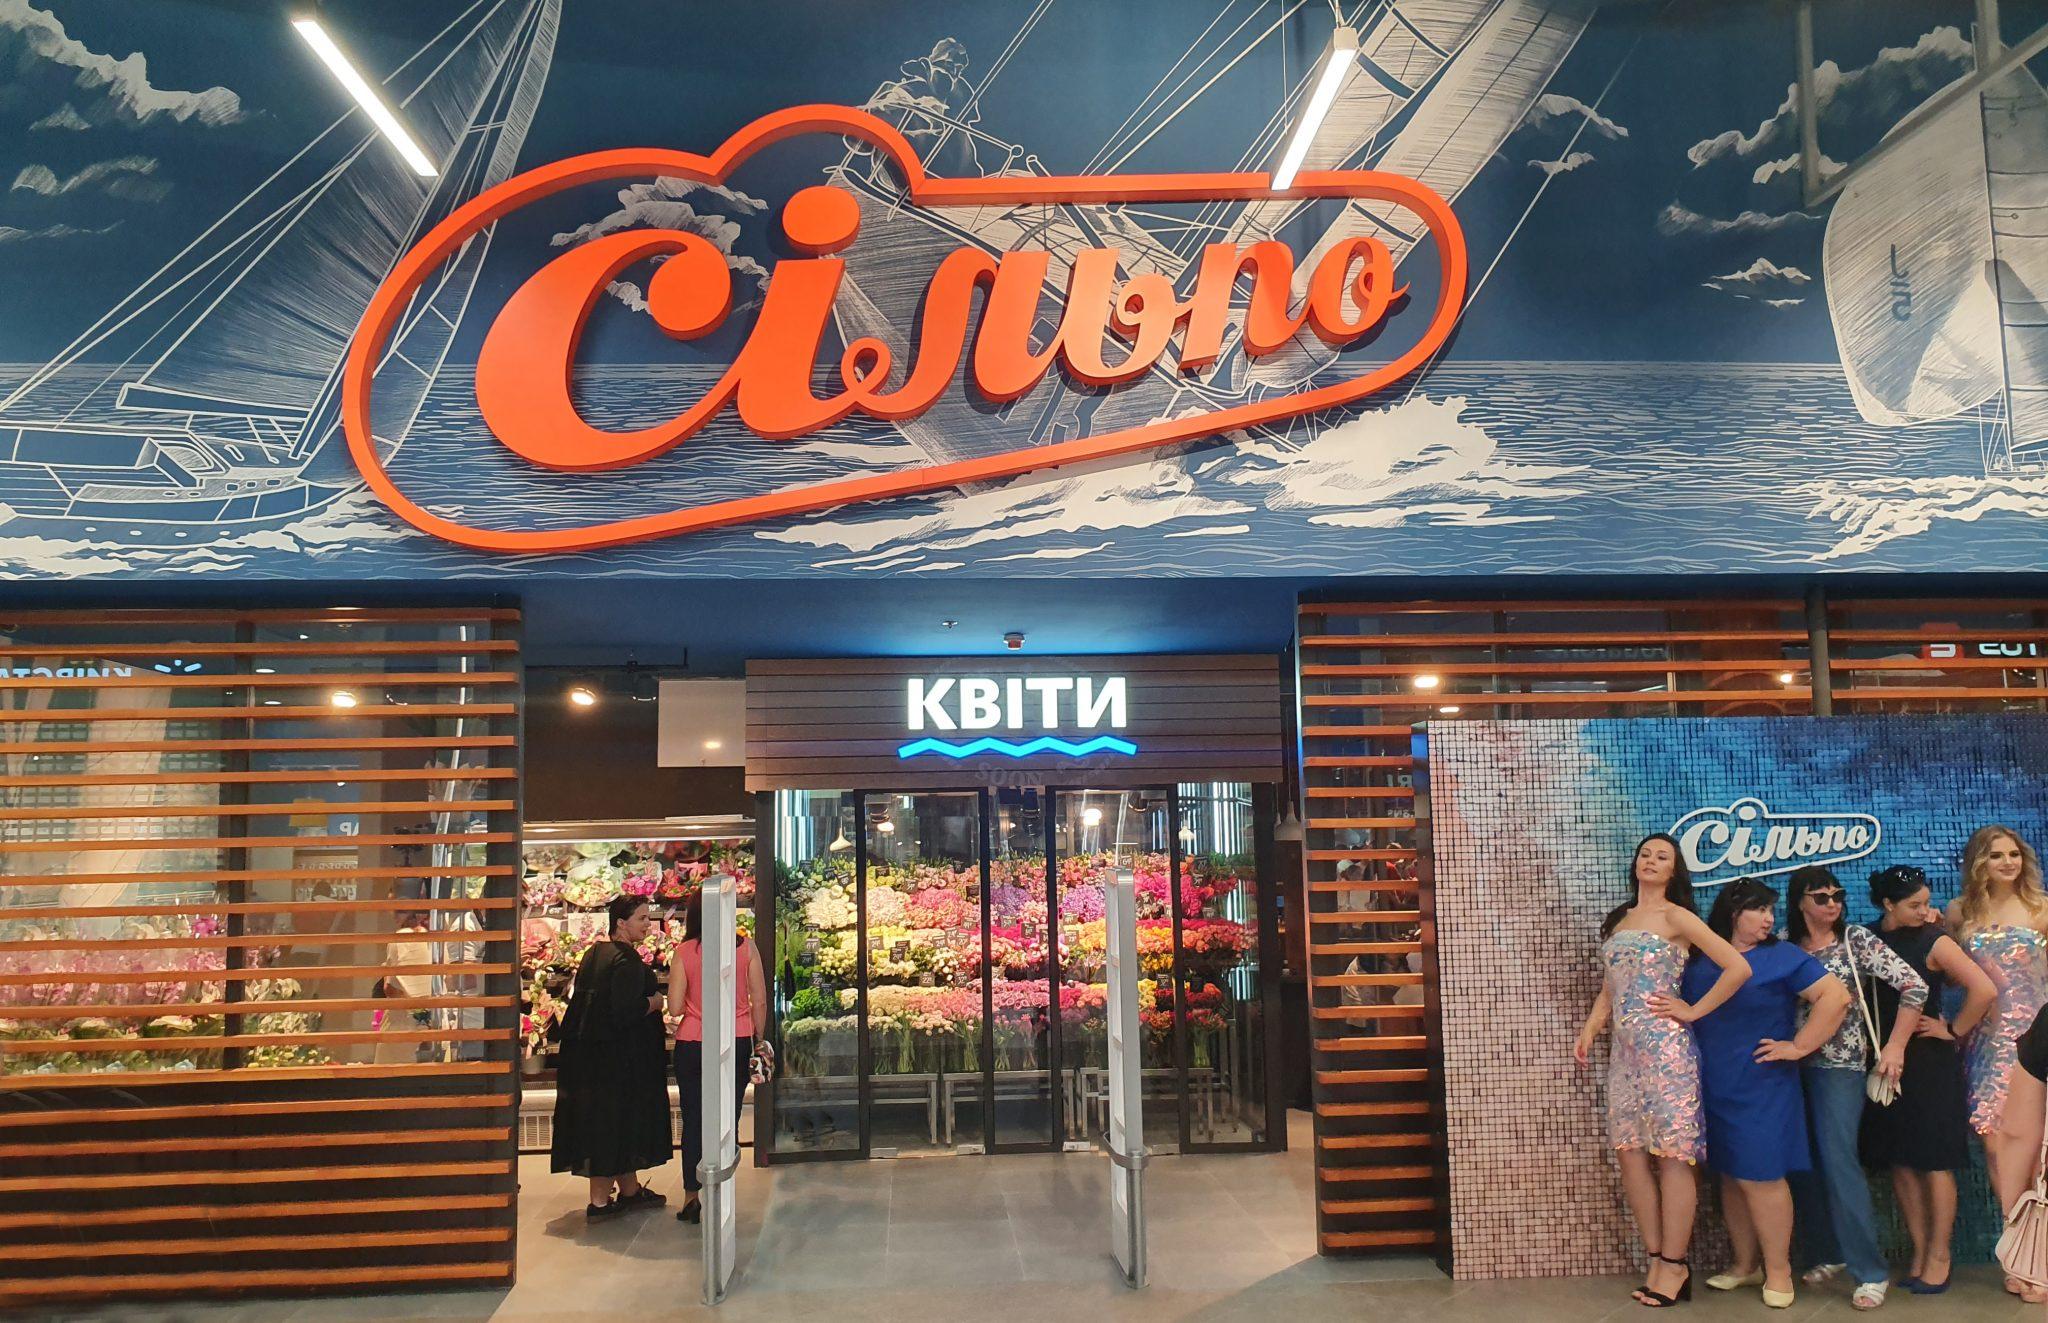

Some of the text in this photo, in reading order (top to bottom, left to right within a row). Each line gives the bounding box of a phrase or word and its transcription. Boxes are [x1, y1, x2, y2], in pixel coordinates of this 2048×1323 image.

[474, 184, 1409, 472] Сільпо
[907, 676, 1127, 730] КВІТИ
[1679, 805, 1869, 873] Сільпо
